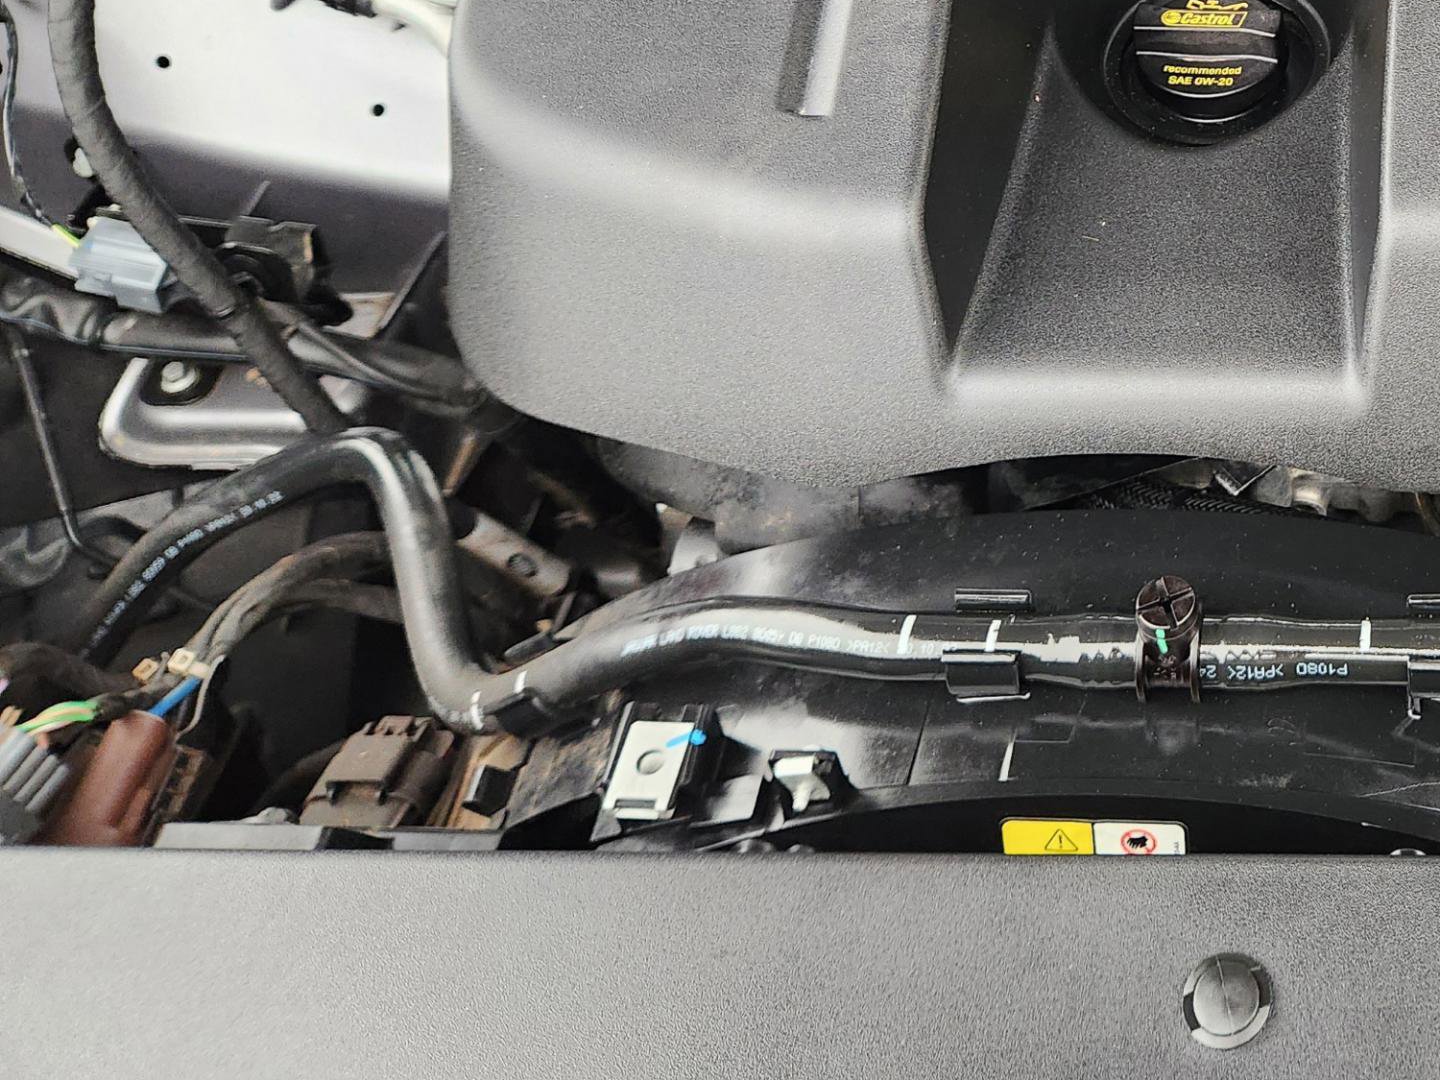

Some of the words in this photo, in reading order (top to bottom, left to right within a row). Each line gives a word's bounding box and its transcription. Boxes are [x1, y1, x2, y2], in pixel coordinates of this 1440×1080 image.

[1180, 12, 1235, 26] Castrol
[1163, 64, 1243, 76] recommended
[1167, 75, 1193, 86] SAE
[1194, 76, 1234, 86] 0W-20
